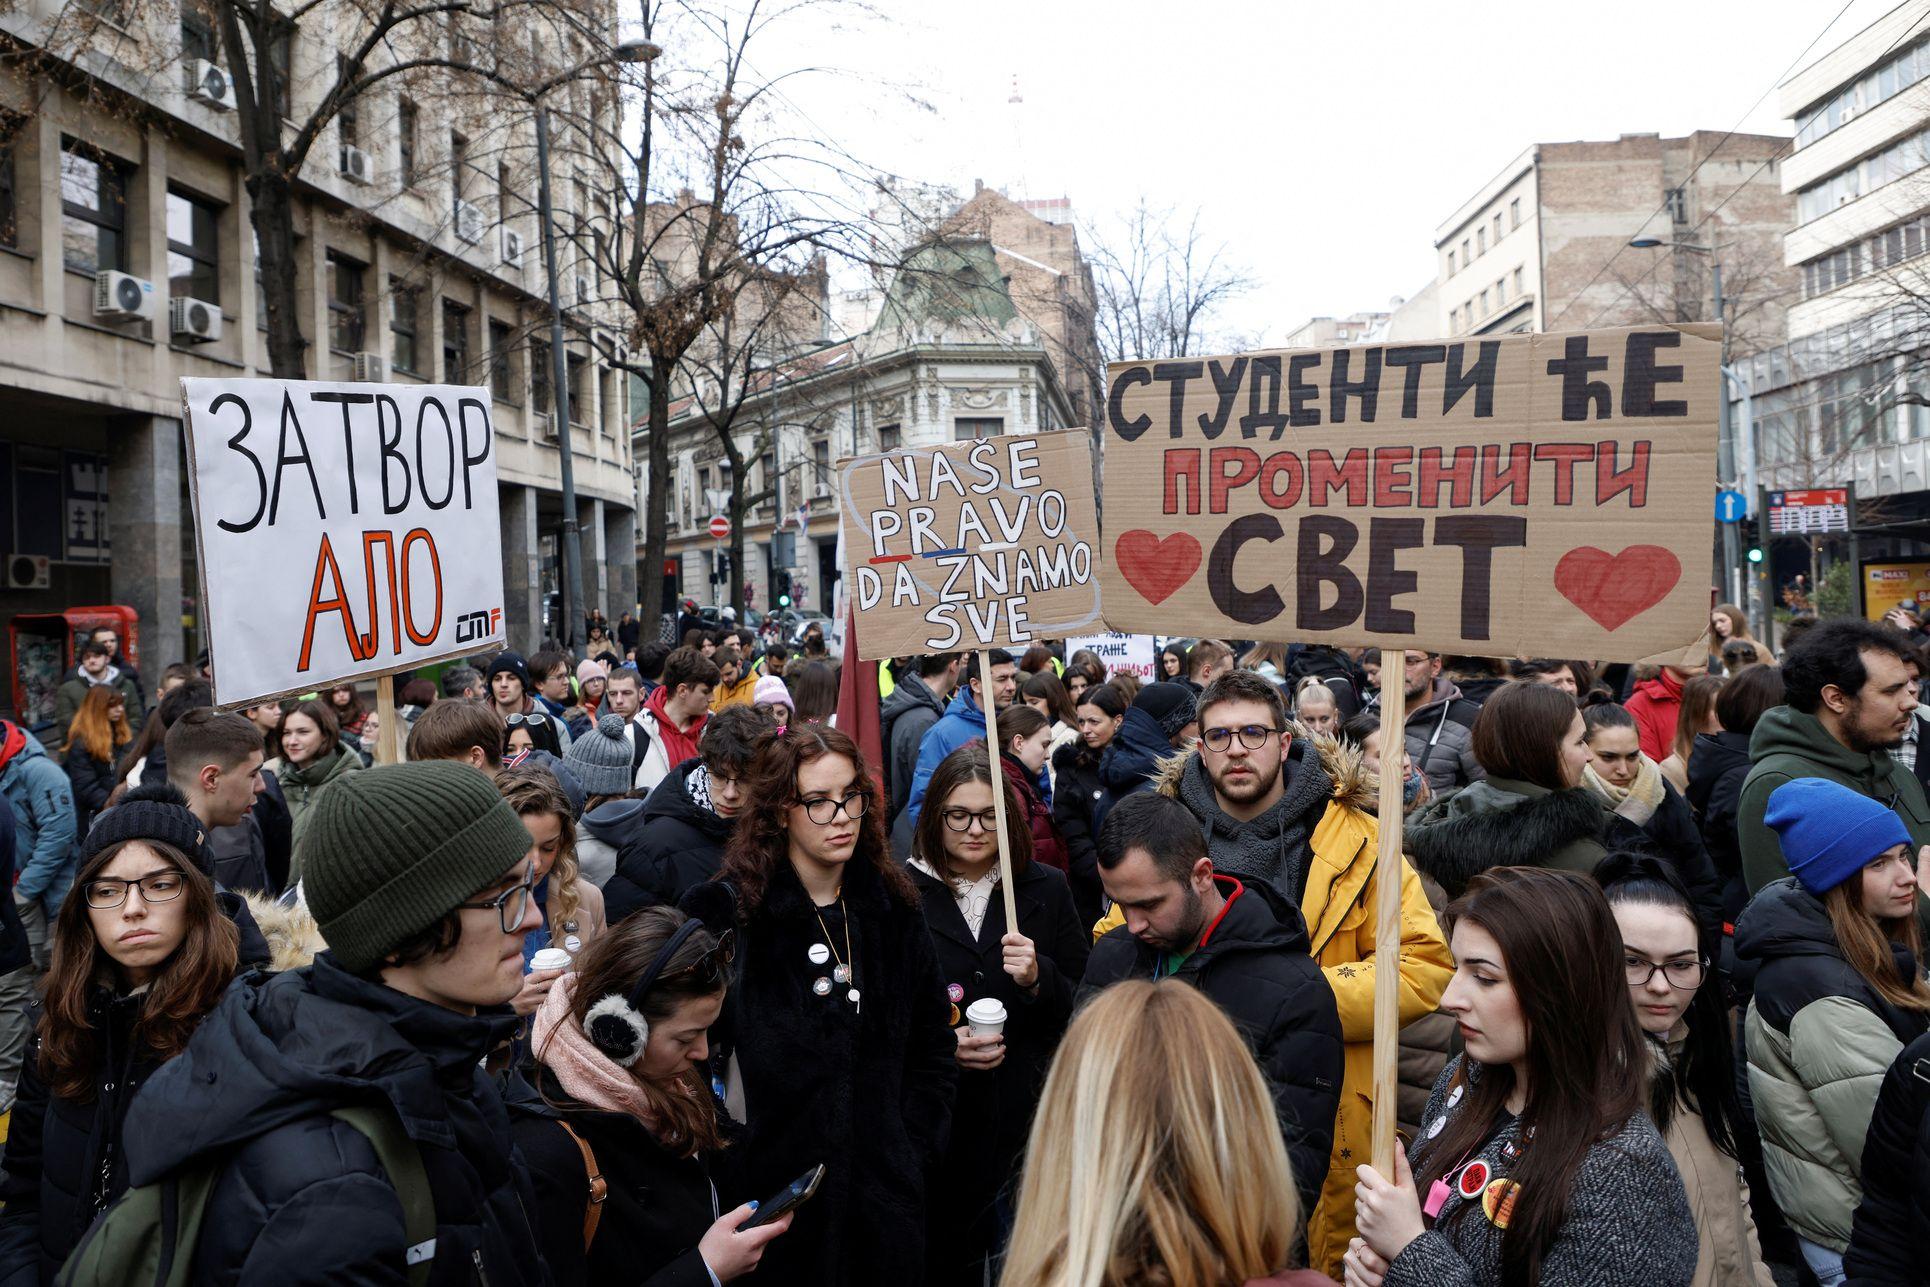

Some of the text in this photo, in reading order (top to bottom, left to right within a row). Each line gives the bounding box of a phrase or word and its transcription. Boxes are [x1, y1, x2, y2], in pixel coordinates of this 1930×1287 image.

[1108, 341, 1500, 441] СТУДЕНТИ
[208, 387, 490, 533] ЗАТВОР
[881, 438, 1041, 507] NAŠE
[1163, 440, 1652, 515] ПРОМЕНИТИ
[871, 490, 1066, 557] PRAVO
[297, 528, 443, 672] АЛО
[856, 541, 1092, 611] DA ZNAMO
[1207, 513, 1527, 641] СВЕТ
[925, 595, 1032, 649] SVE
